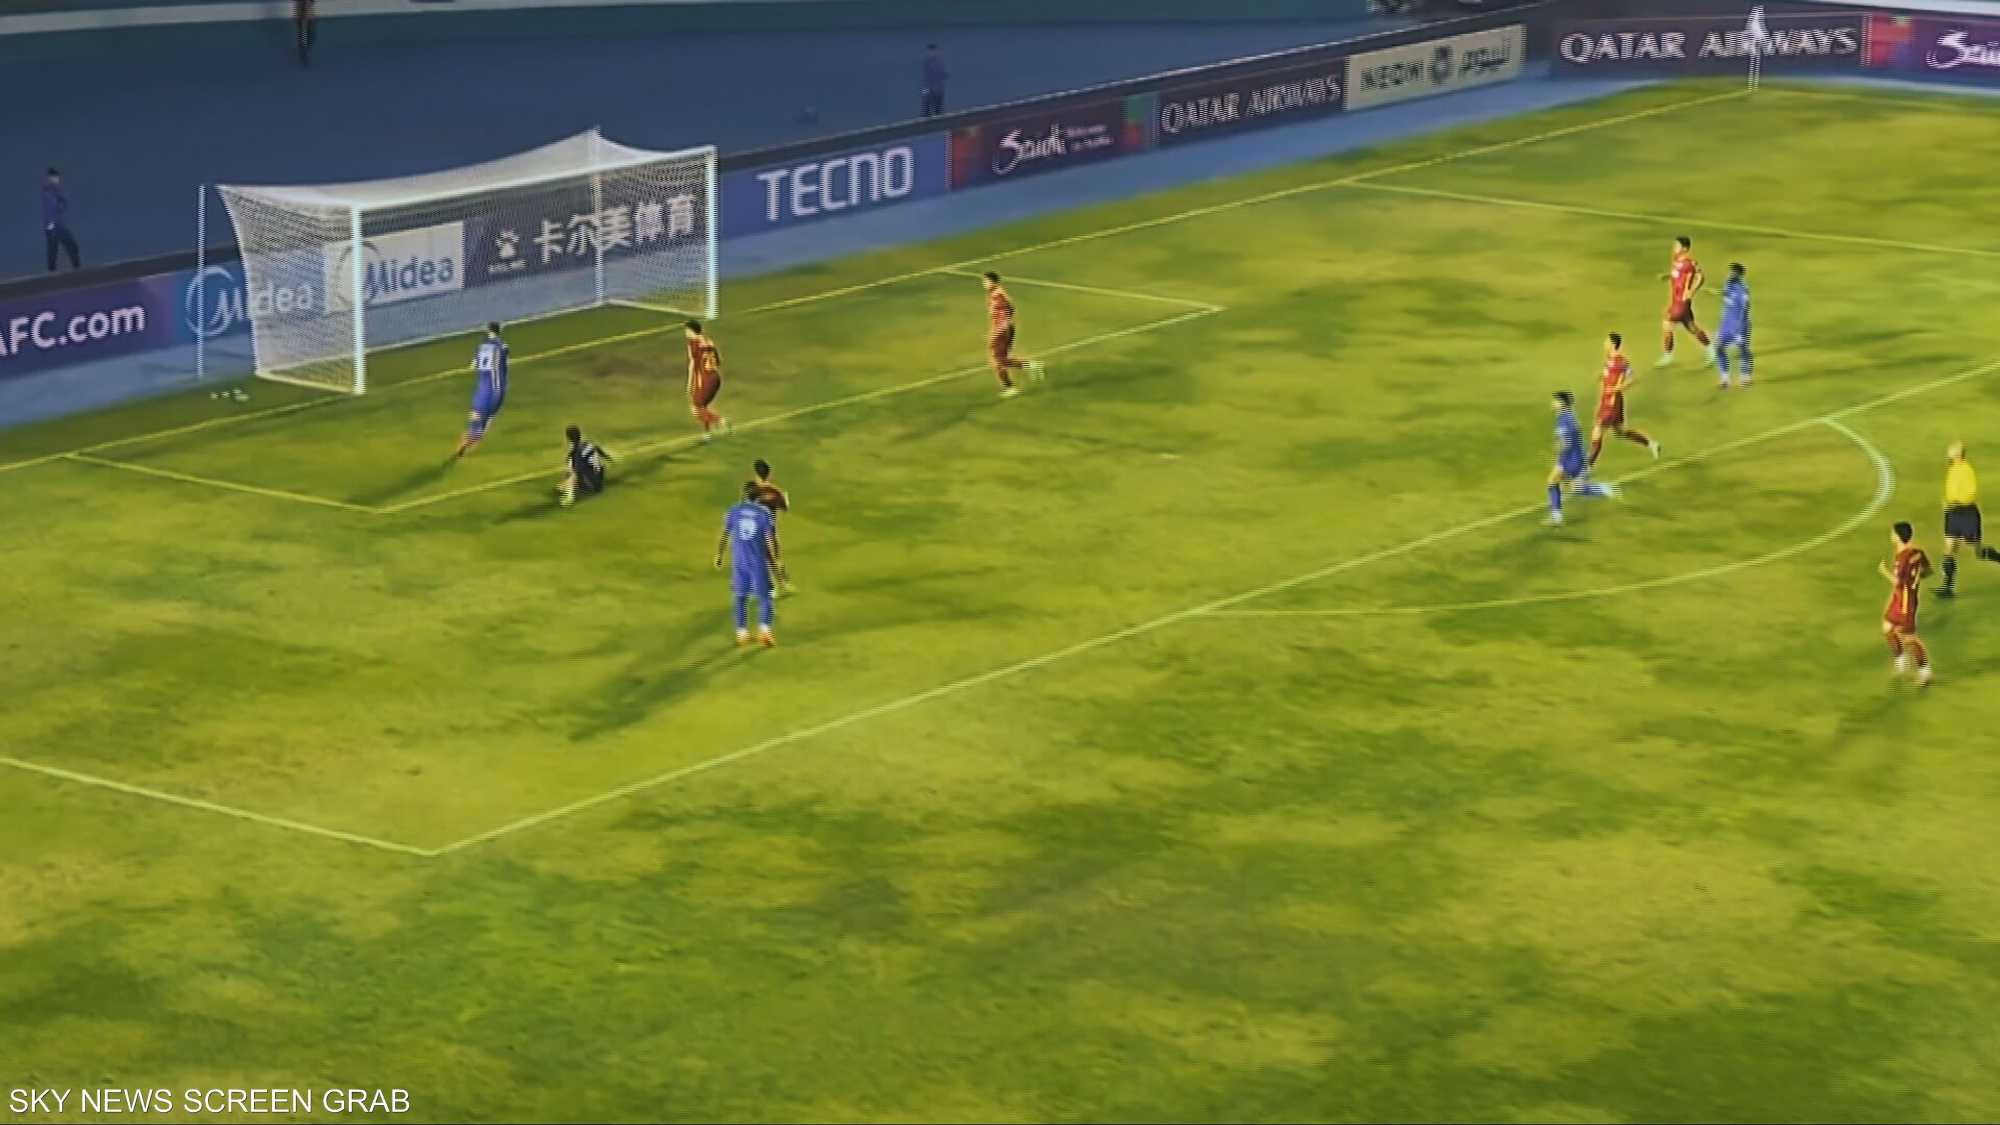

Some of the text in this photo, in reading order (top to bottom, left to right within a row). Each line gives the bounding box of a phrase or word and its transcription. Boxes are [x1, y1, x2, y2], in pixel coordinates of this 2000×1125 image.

[1559, 27, 1857, 63] QATAR AIRWAYS
[1160, 92, 1240, 134] QATAR
[758, 148, 914, 221] TECNO
